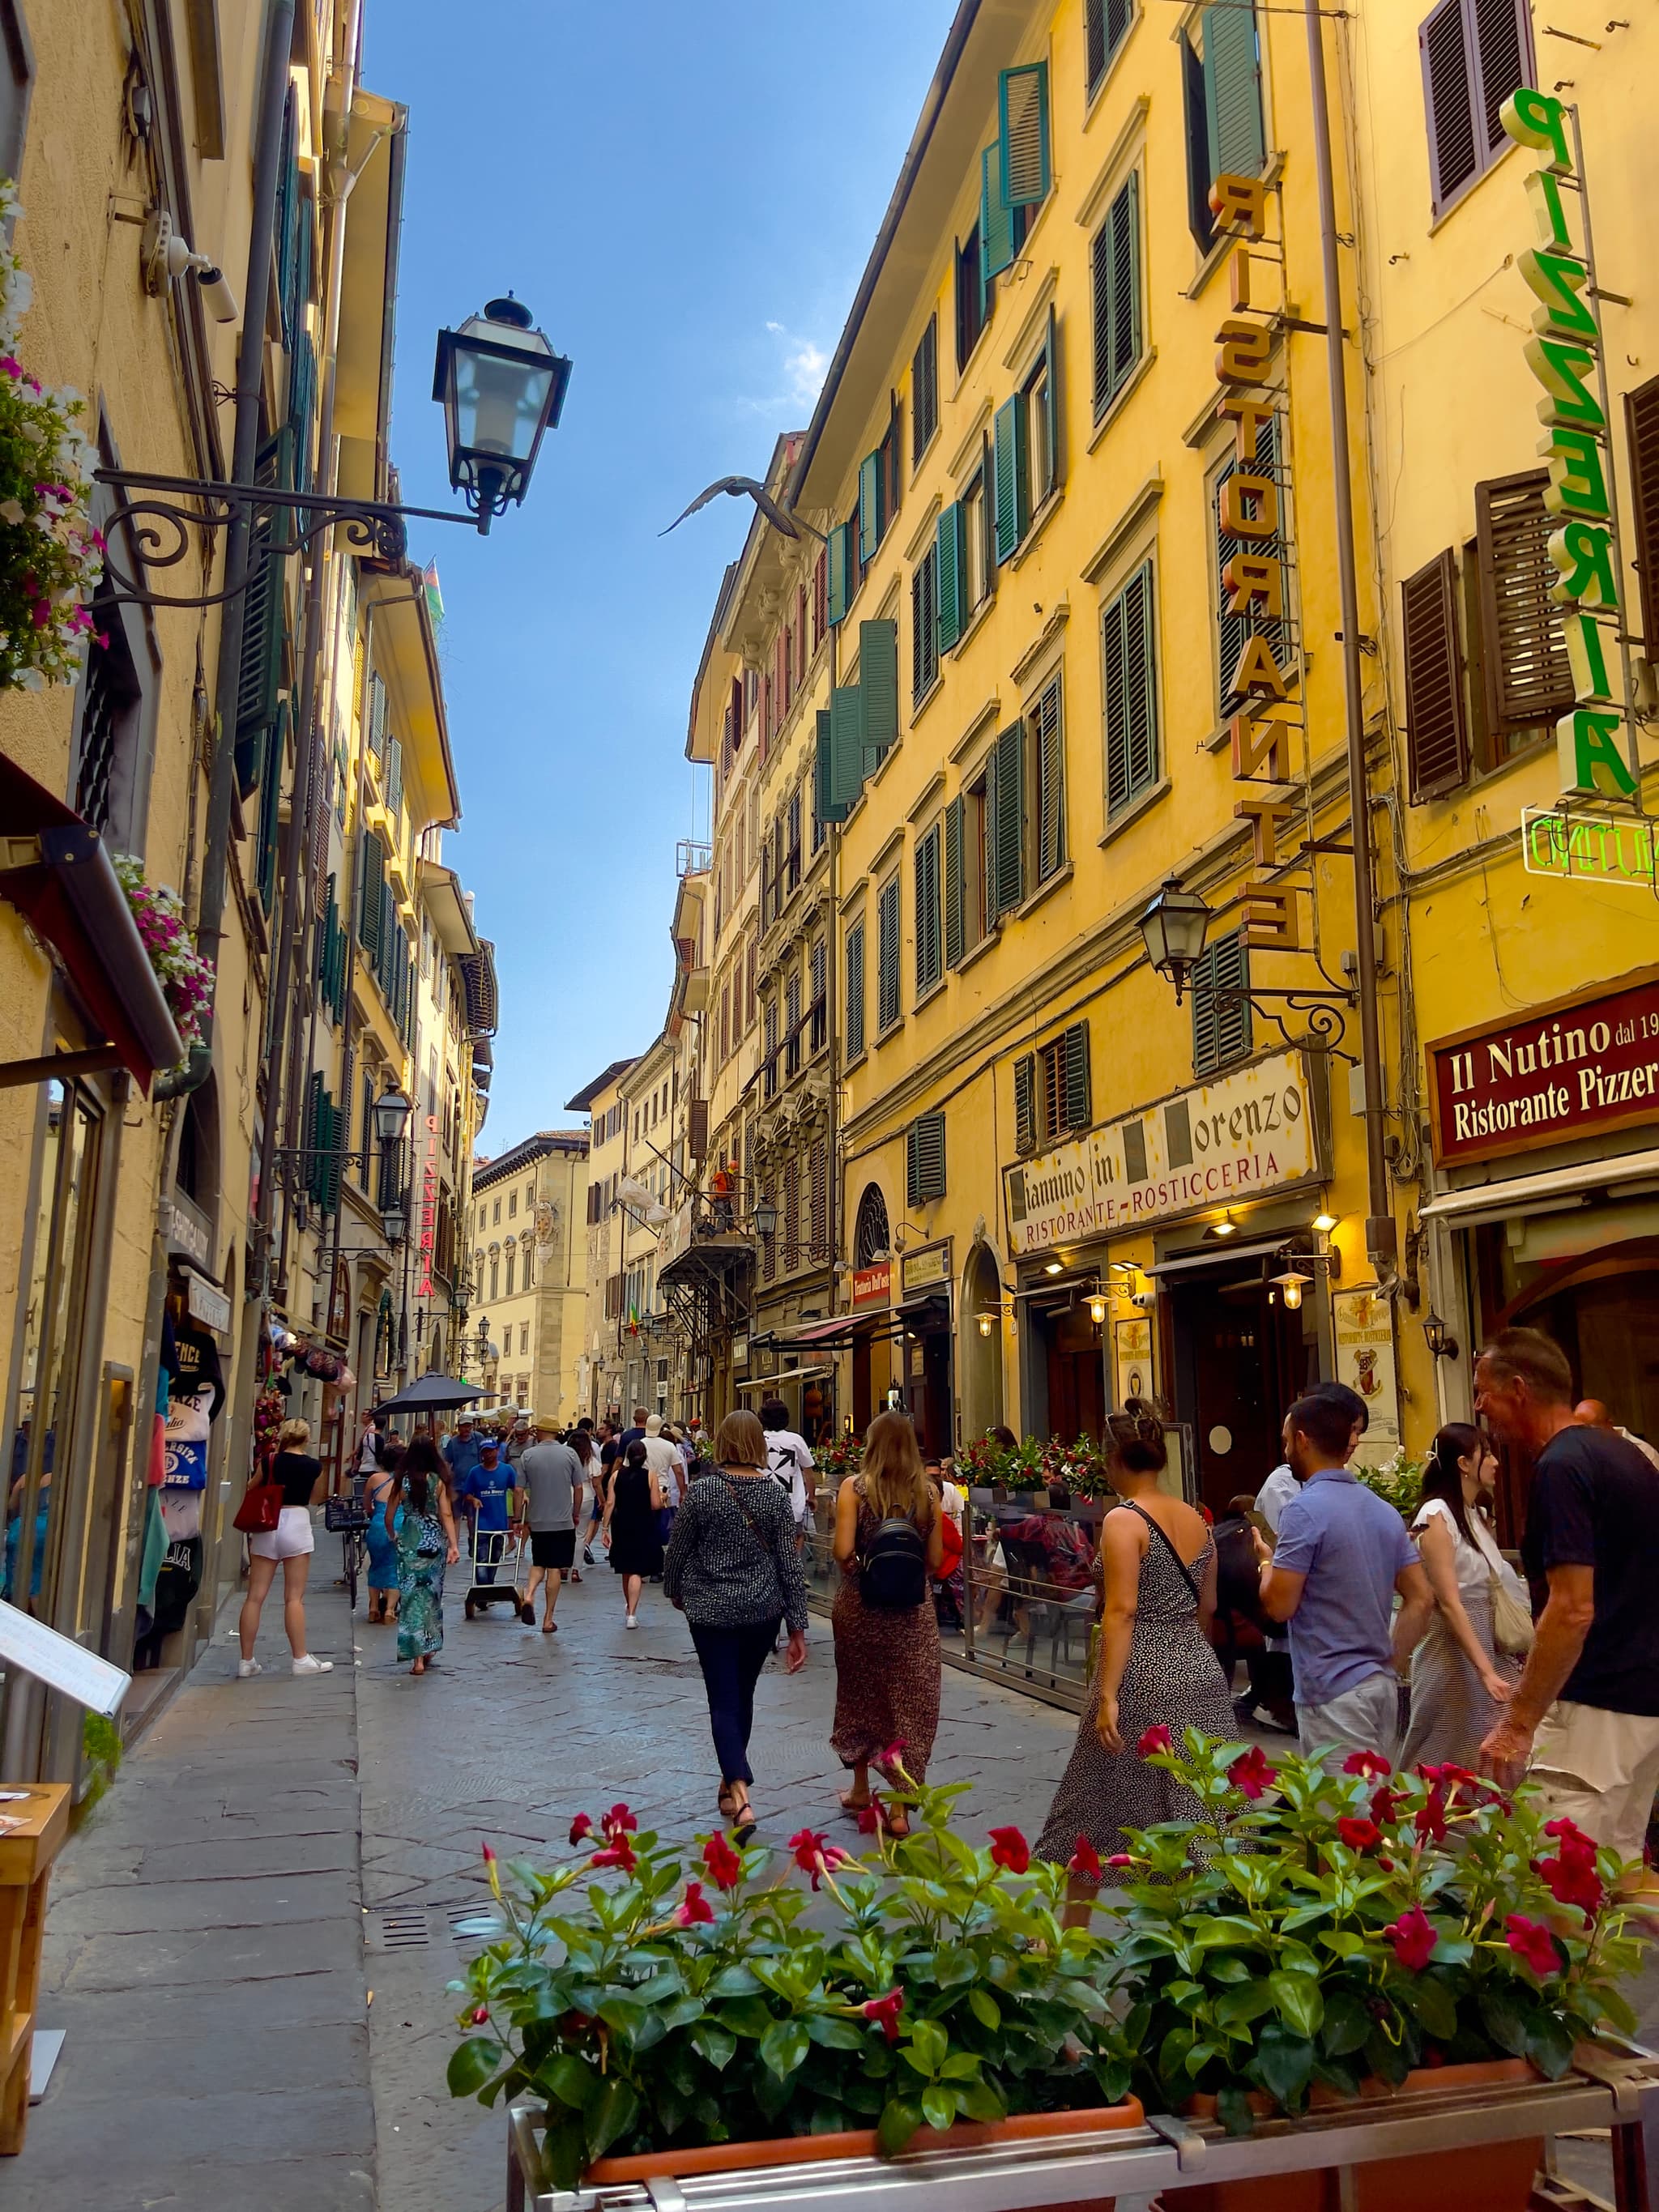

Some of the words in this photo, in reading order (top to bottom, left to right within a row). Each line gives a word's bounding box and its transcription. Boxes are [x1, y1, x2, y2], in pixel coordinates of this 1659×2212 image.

[1449, 1052, 1474, 1094] Il
[1486, 1023, 1610, 1083] Nutino
[1615, 1019, 1636, 1046] dal
[1453, 1081, 1570, 1141] Ristorante
[1009, 1158, 1085, 1223] iannino
[1094, 1143, 1114, 1187] in
[1164, 1085, 1302, 1170] orenzo
